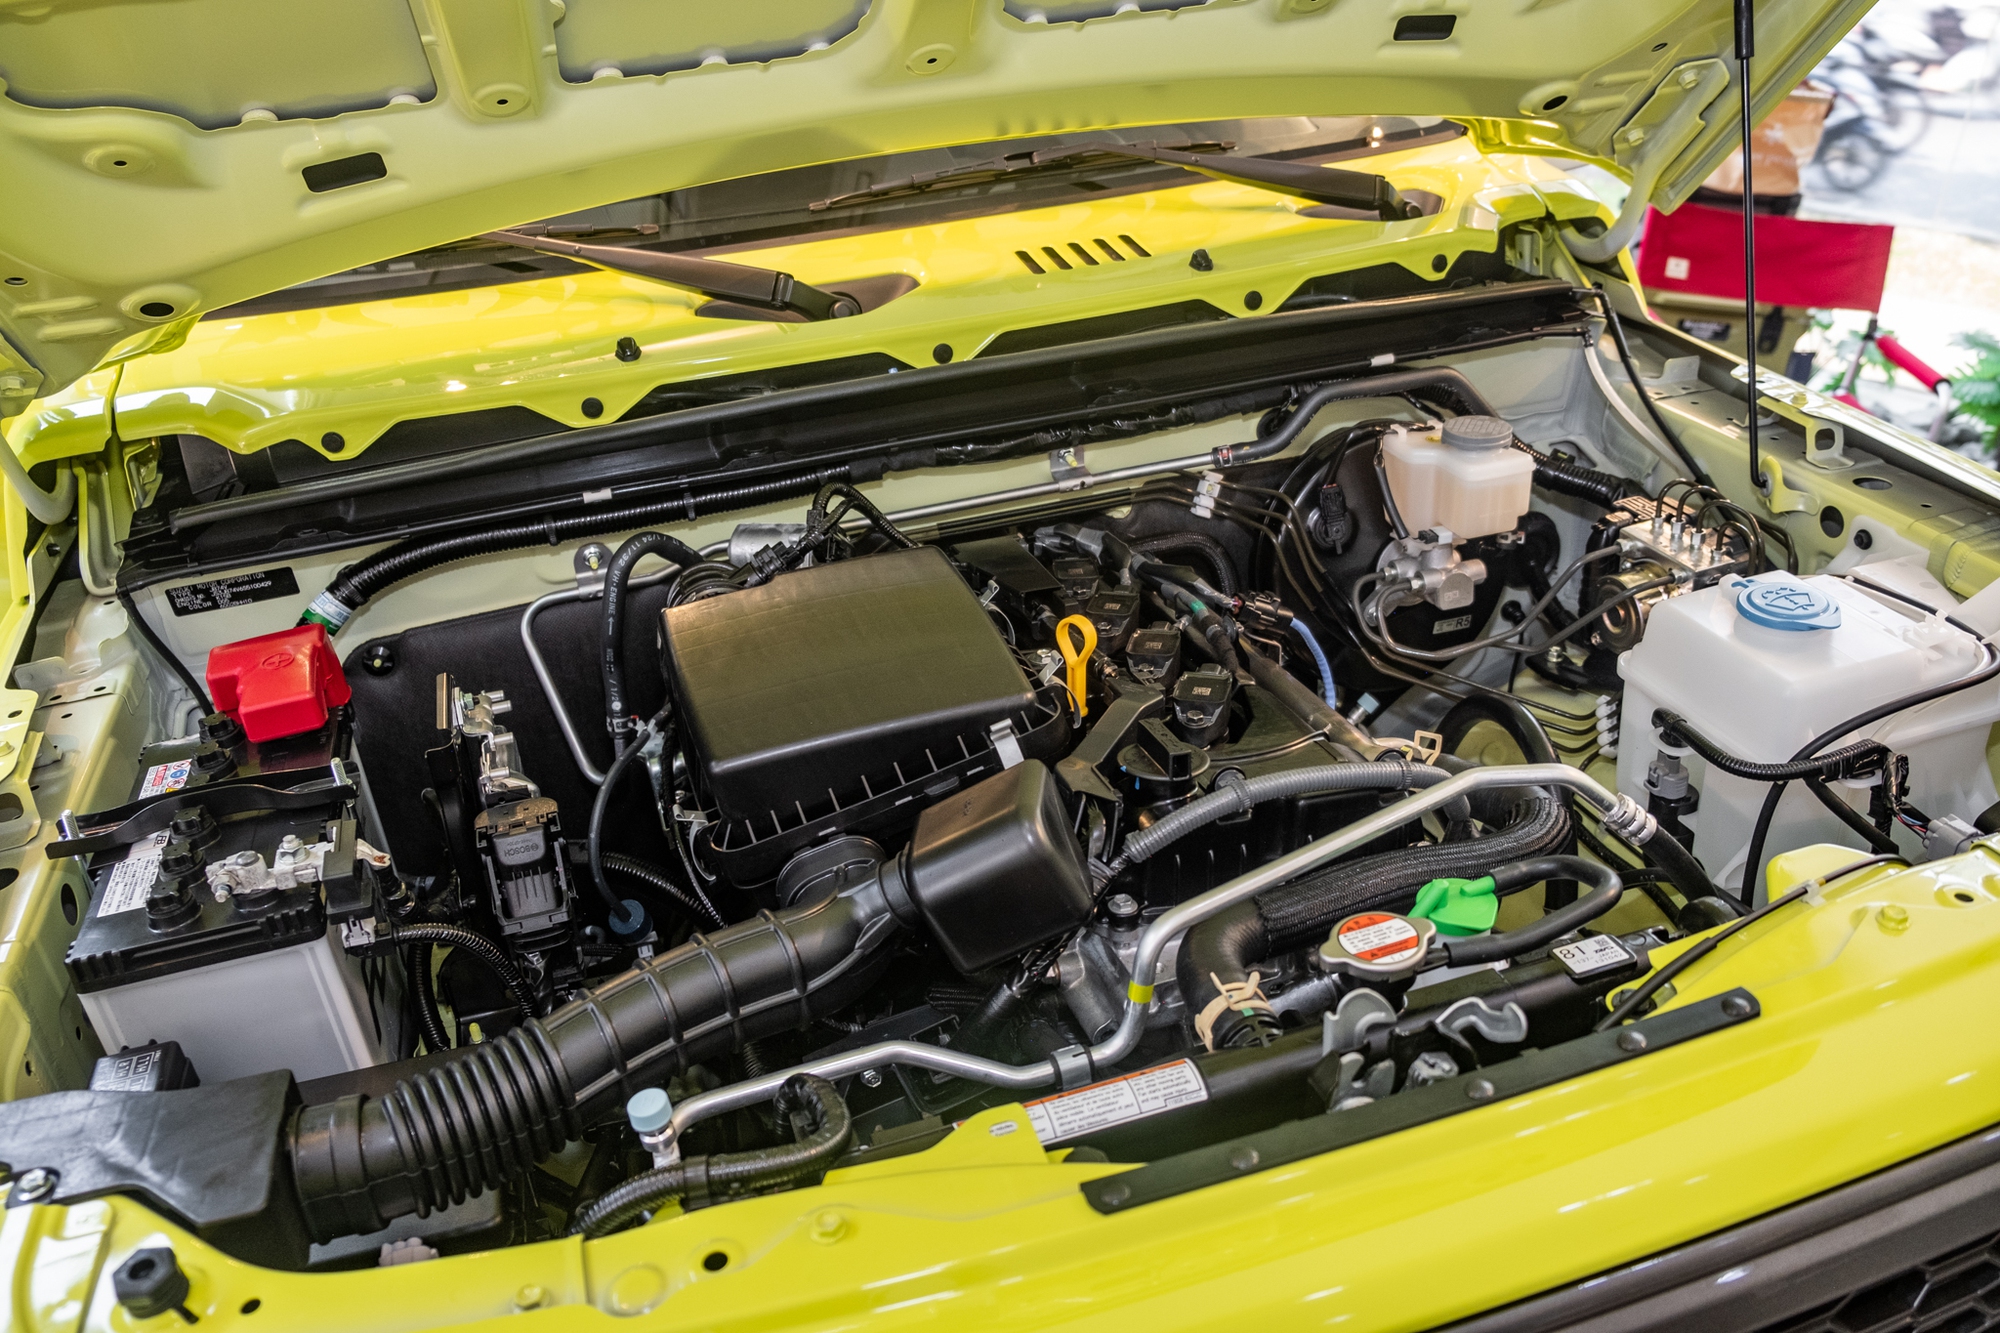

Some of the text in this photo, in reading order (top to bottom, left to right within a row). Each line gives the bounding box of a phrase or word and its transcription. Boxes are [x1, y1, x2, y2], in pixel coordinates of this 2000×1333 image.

[169, 572, 265, 595] SUZUKI MOTOR CORPORATION
[189, 602, 212, 610] COLOR
[504, 845, 530, 857] BOSCH
[1560, 946, 1585, 959] 81
[136, 1056, 150, 1073] HLL
